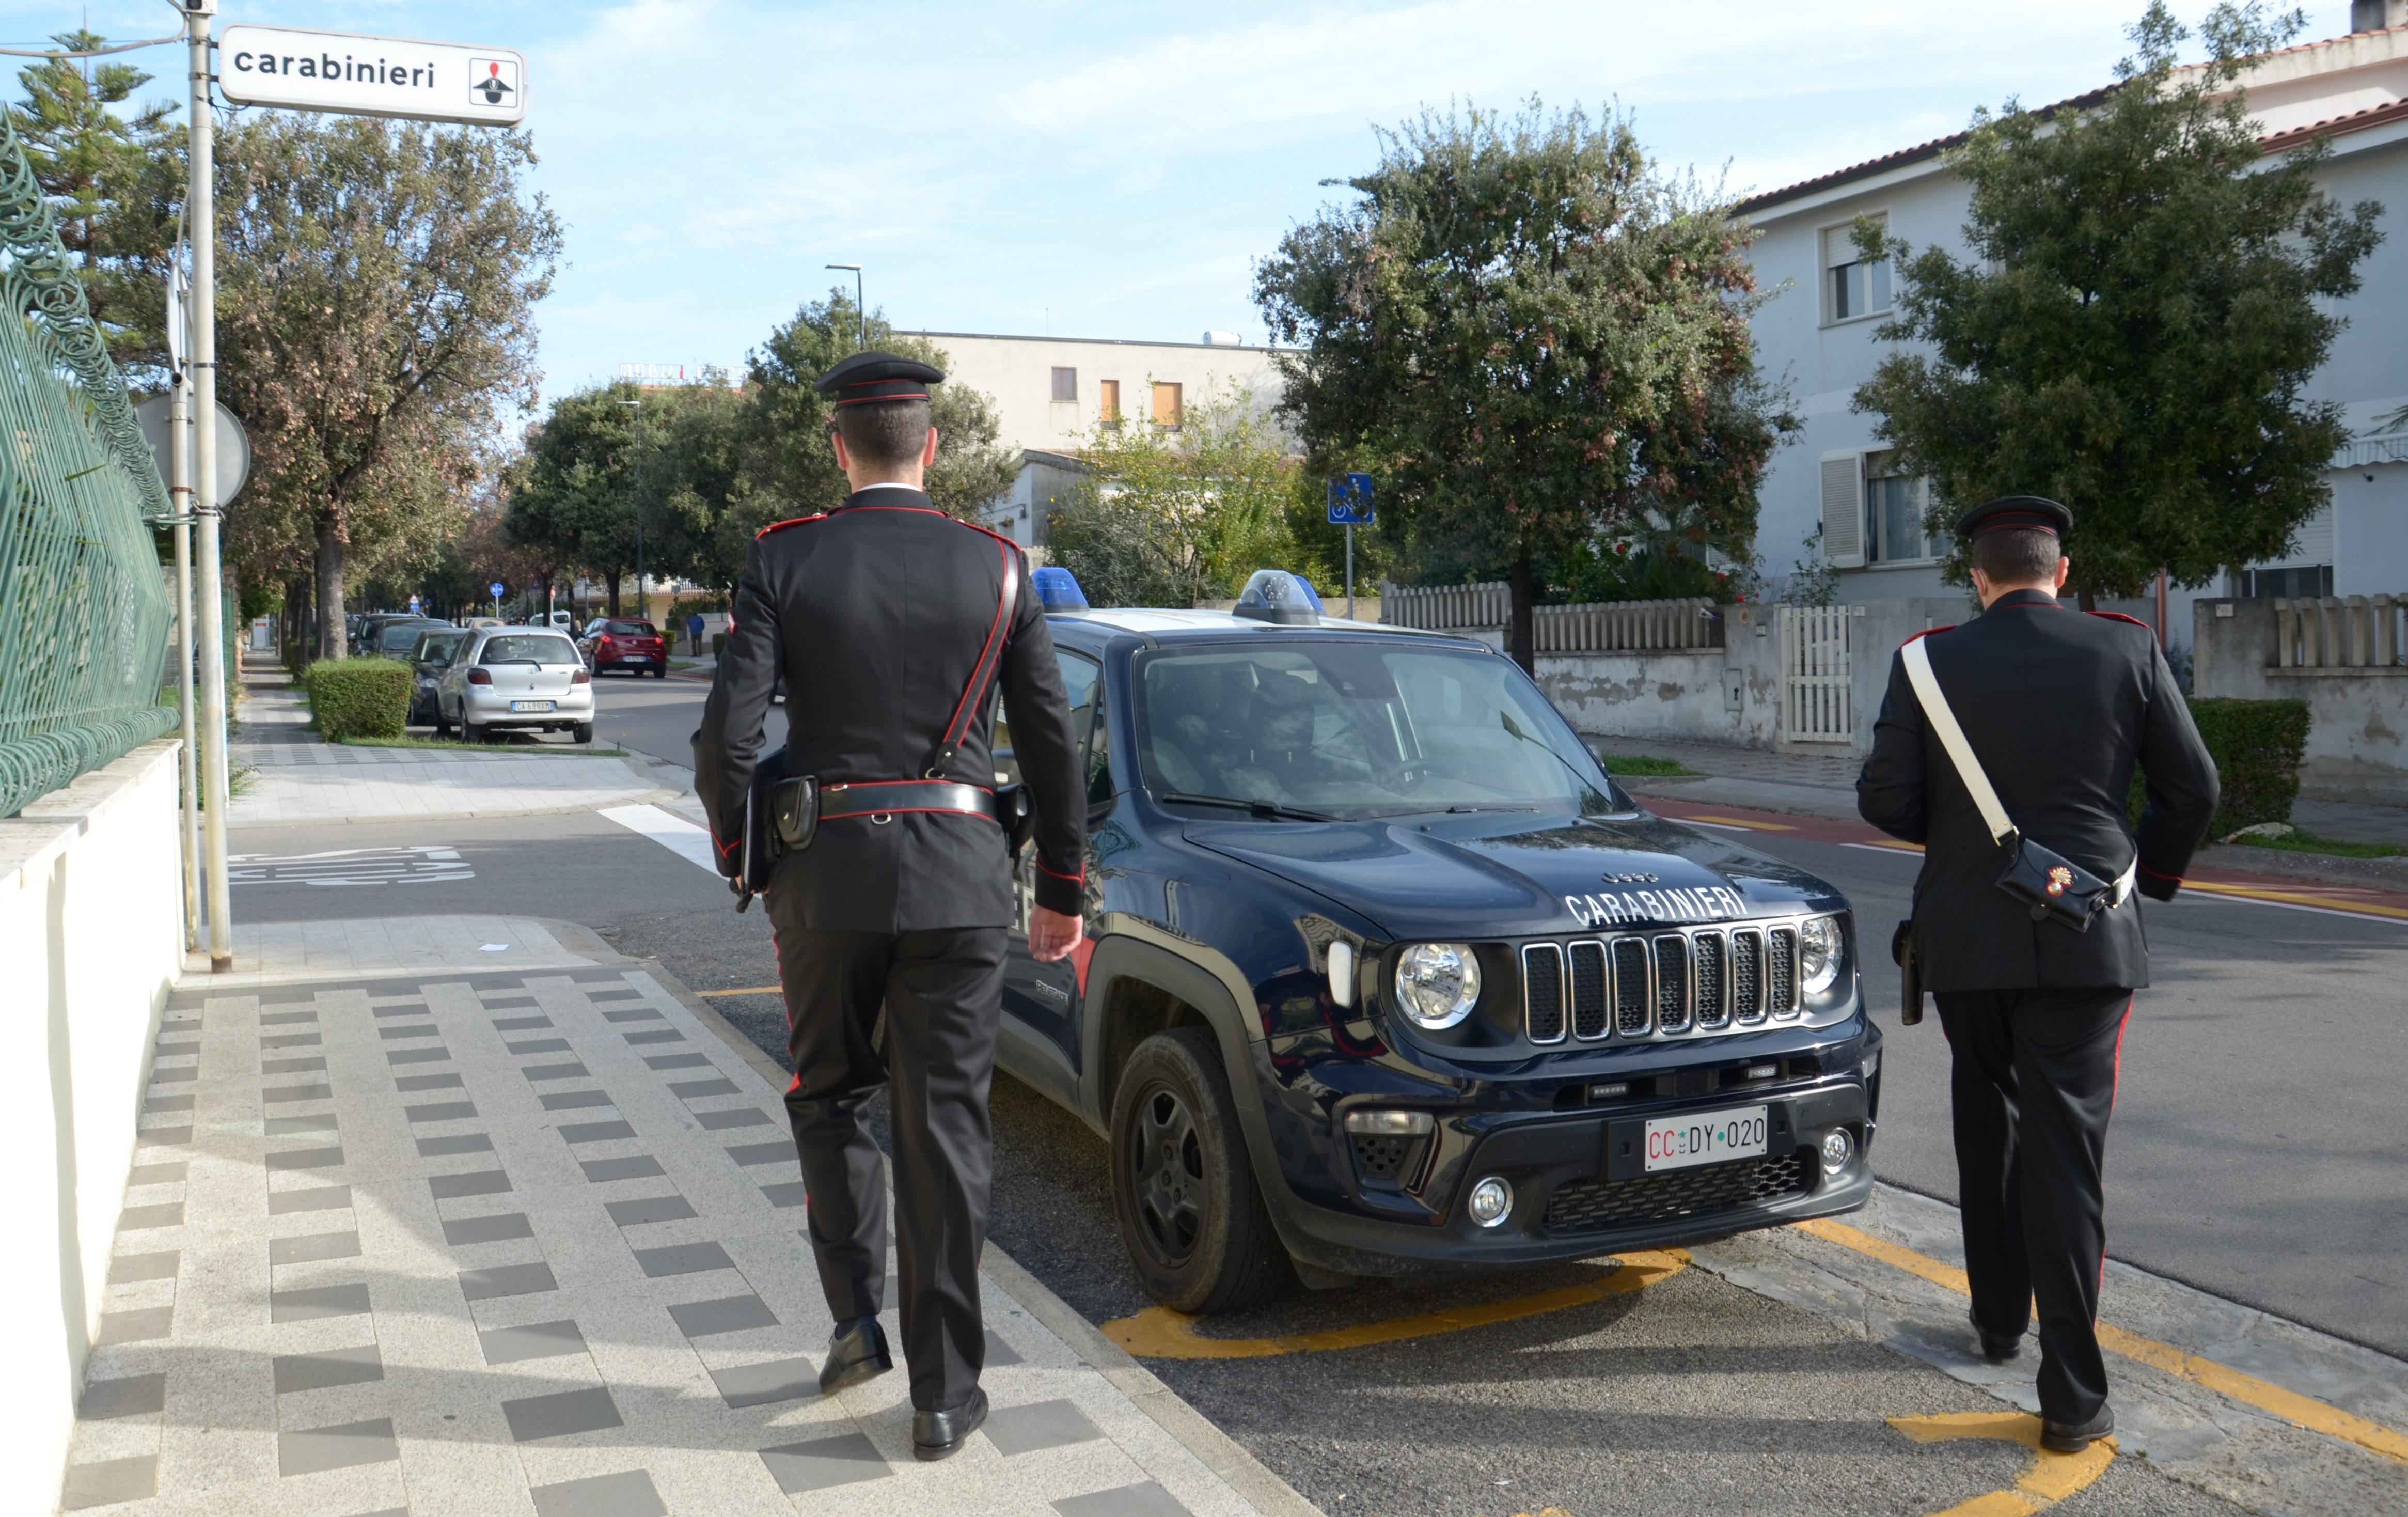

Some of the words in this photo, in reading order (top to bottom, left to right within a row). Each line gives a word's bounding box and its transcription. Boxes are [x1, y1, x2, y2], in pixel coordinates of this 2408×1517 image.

[234, 52, 434, 88] carabinieri
[1565, 886, 1748, 926] CARABINIERI
[1649, 1130, 1675, 1159] CC
[1690, 1124, 1714, 1154] DY
[1727, 1117, 1765, 1148] 020
